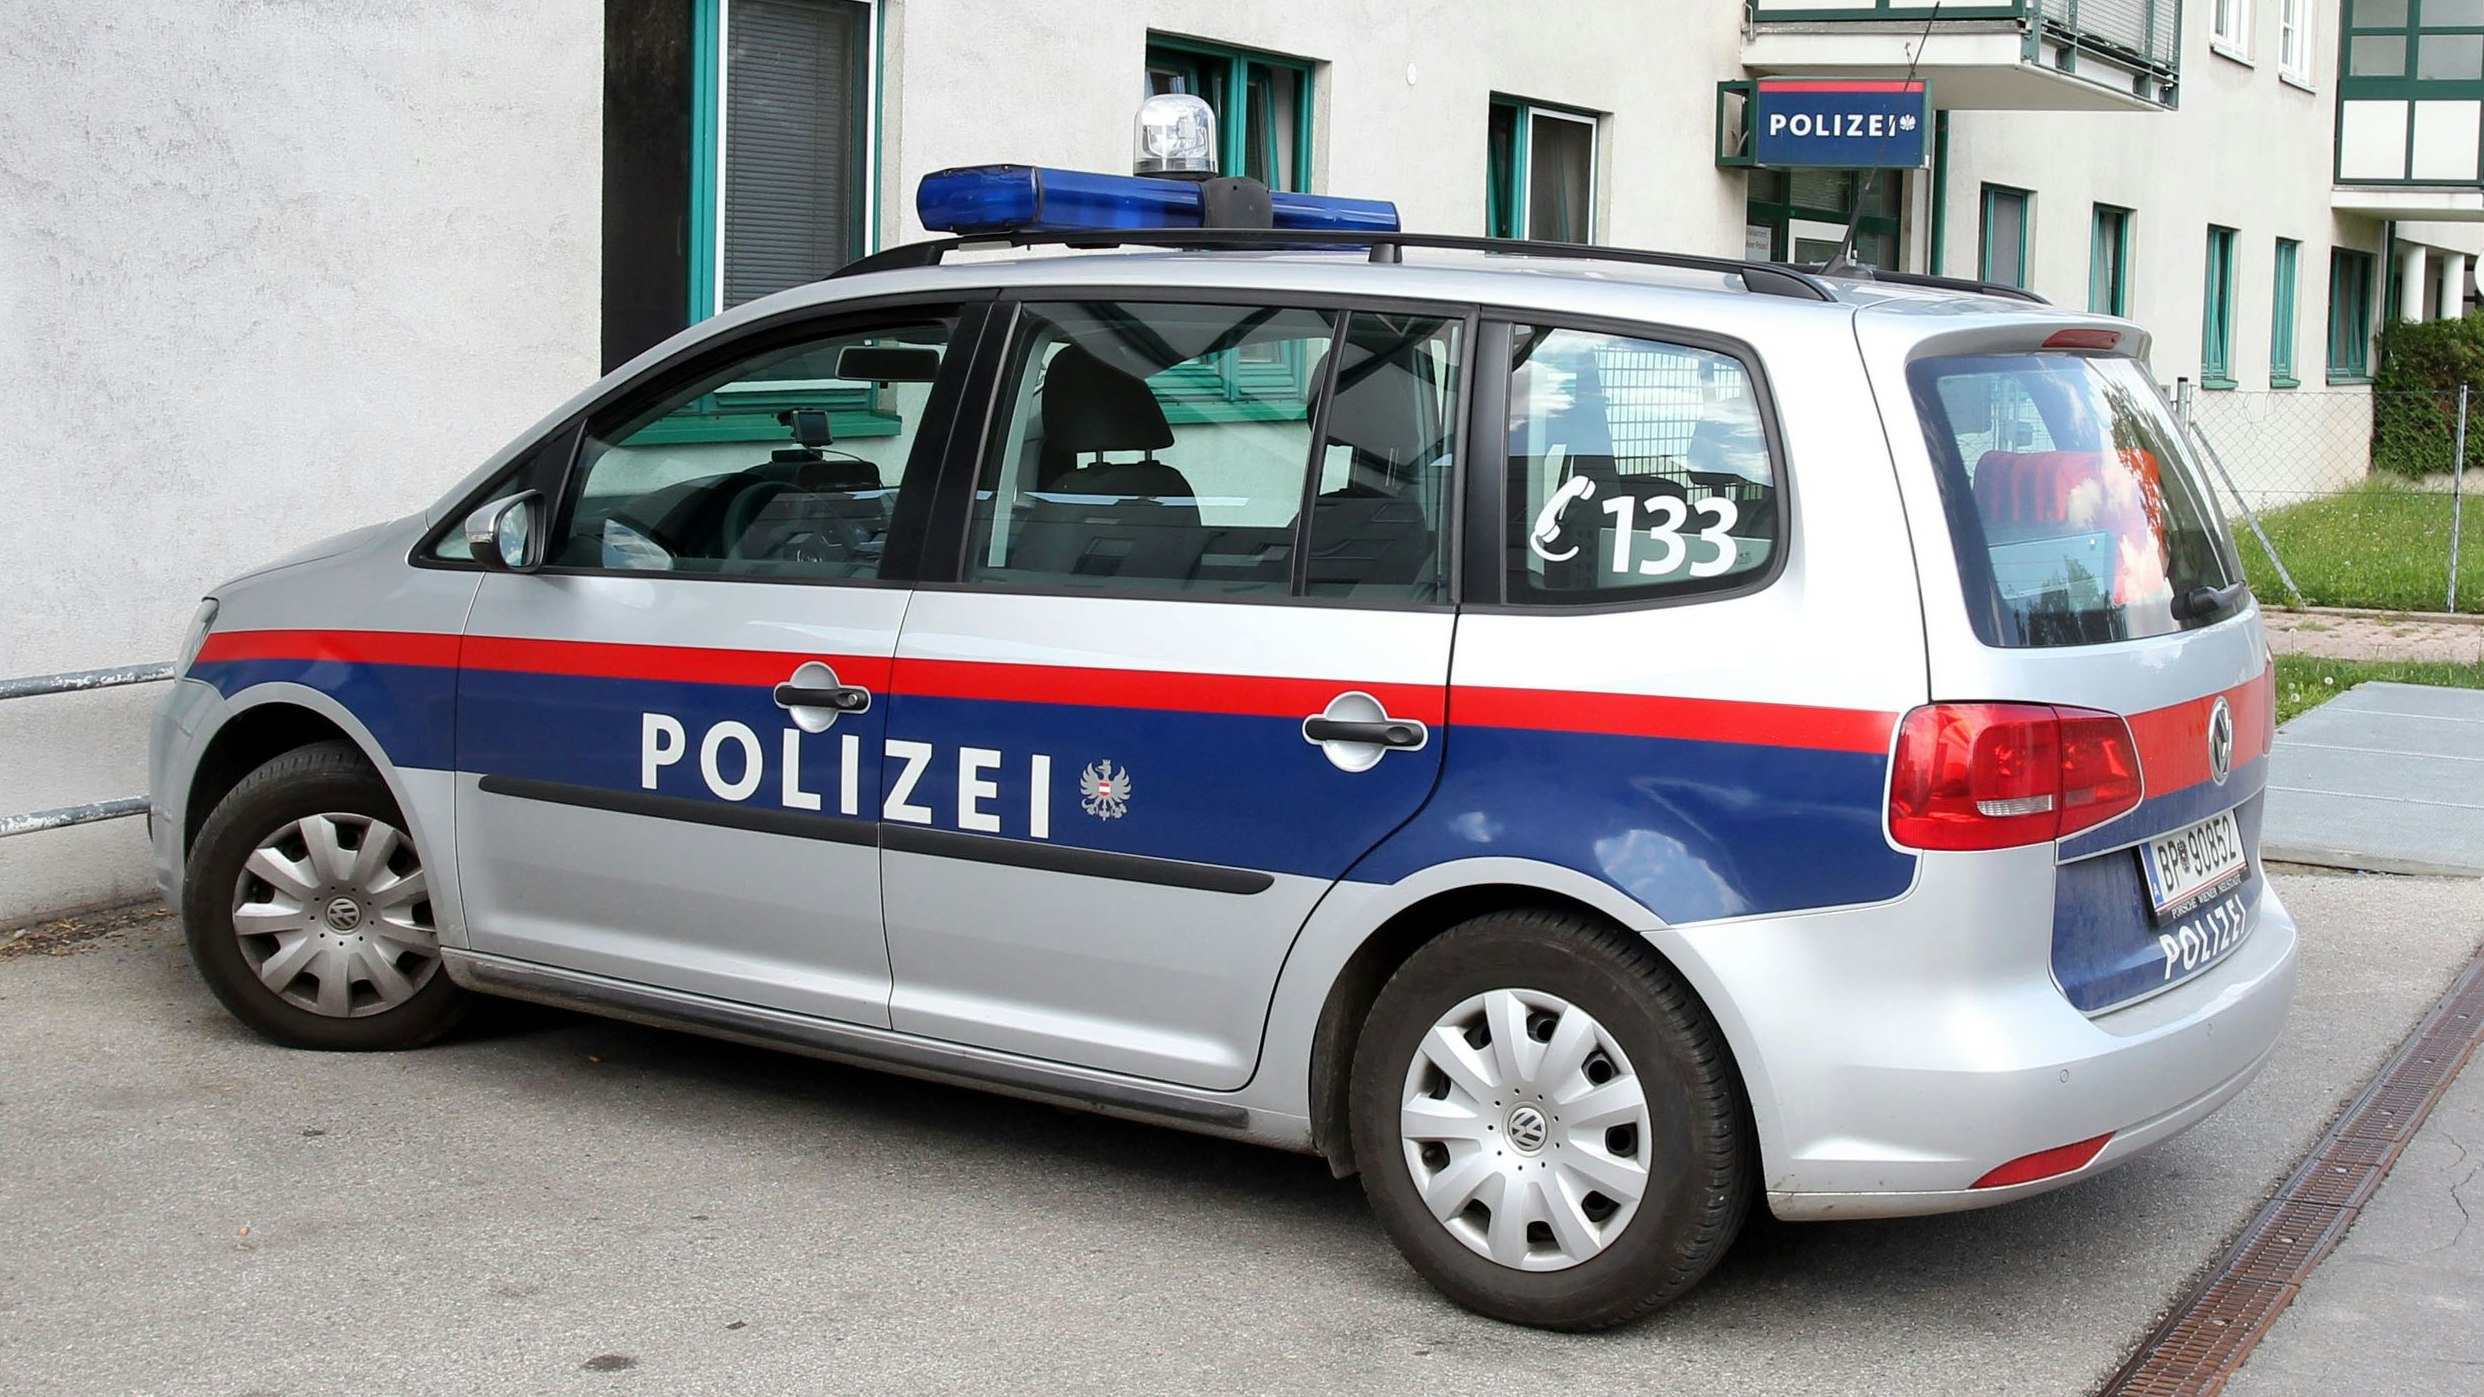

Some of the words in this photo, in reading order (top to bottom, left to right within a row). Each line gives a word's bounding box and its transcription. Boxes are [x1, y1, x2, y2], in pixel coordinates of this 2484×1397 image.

[1769, 113, 1896, 137] POLIZEI
[1602, 495, 1738, 577] 133
[641, 712, 1051, 839] POLIZEI
[2157, 840, 2180, 892] BP
[2188, 816, 2237, 876] 90852
[2159, 894, 2246, 980] POLIZEI
